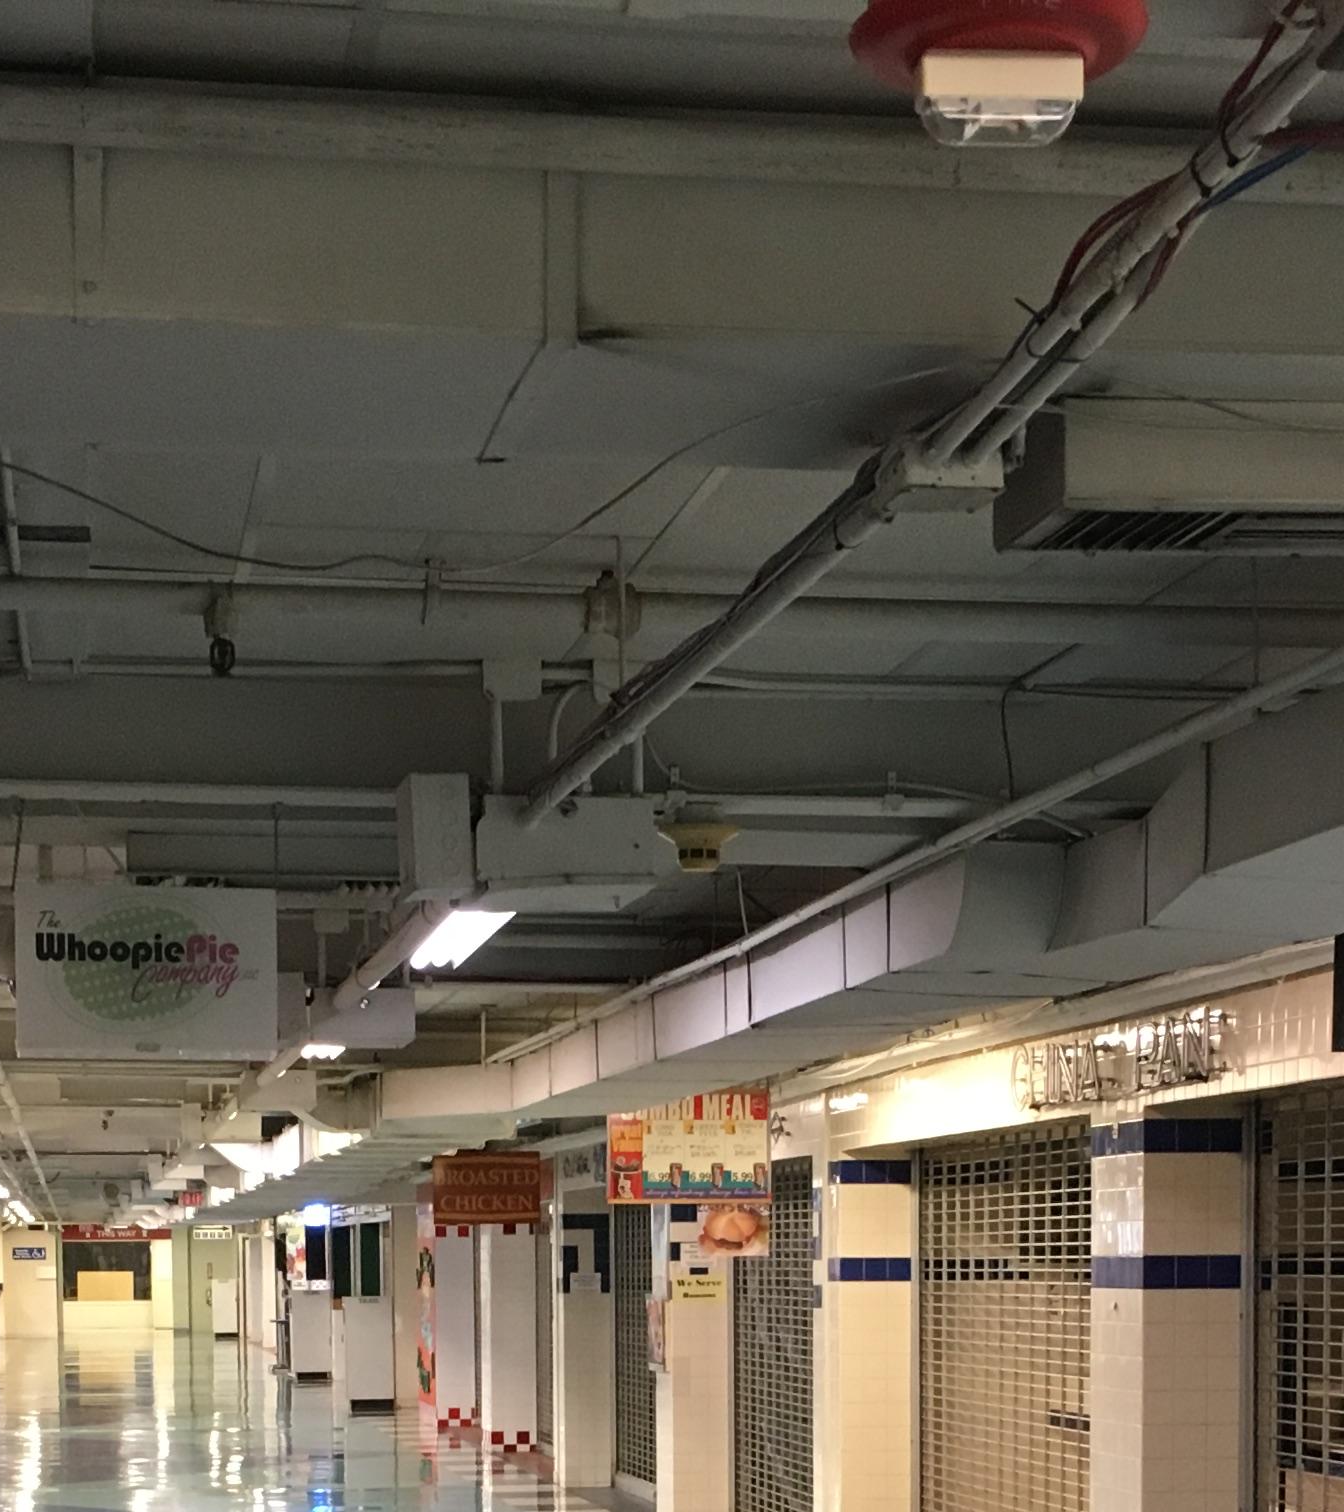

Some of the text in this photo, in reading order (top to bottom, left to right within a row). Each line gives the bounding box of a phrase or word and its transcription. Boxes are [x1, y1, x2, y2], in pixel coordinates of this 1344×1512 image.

[37, 910, 62, 928] The
[131, 964, 240, 1003] Company
[1011, 1006, 1209, 1111] CHINA PAN
[702, 1094, 754, 1120] MEAL
[441, 1194, 533, 1211] CHICKEN
